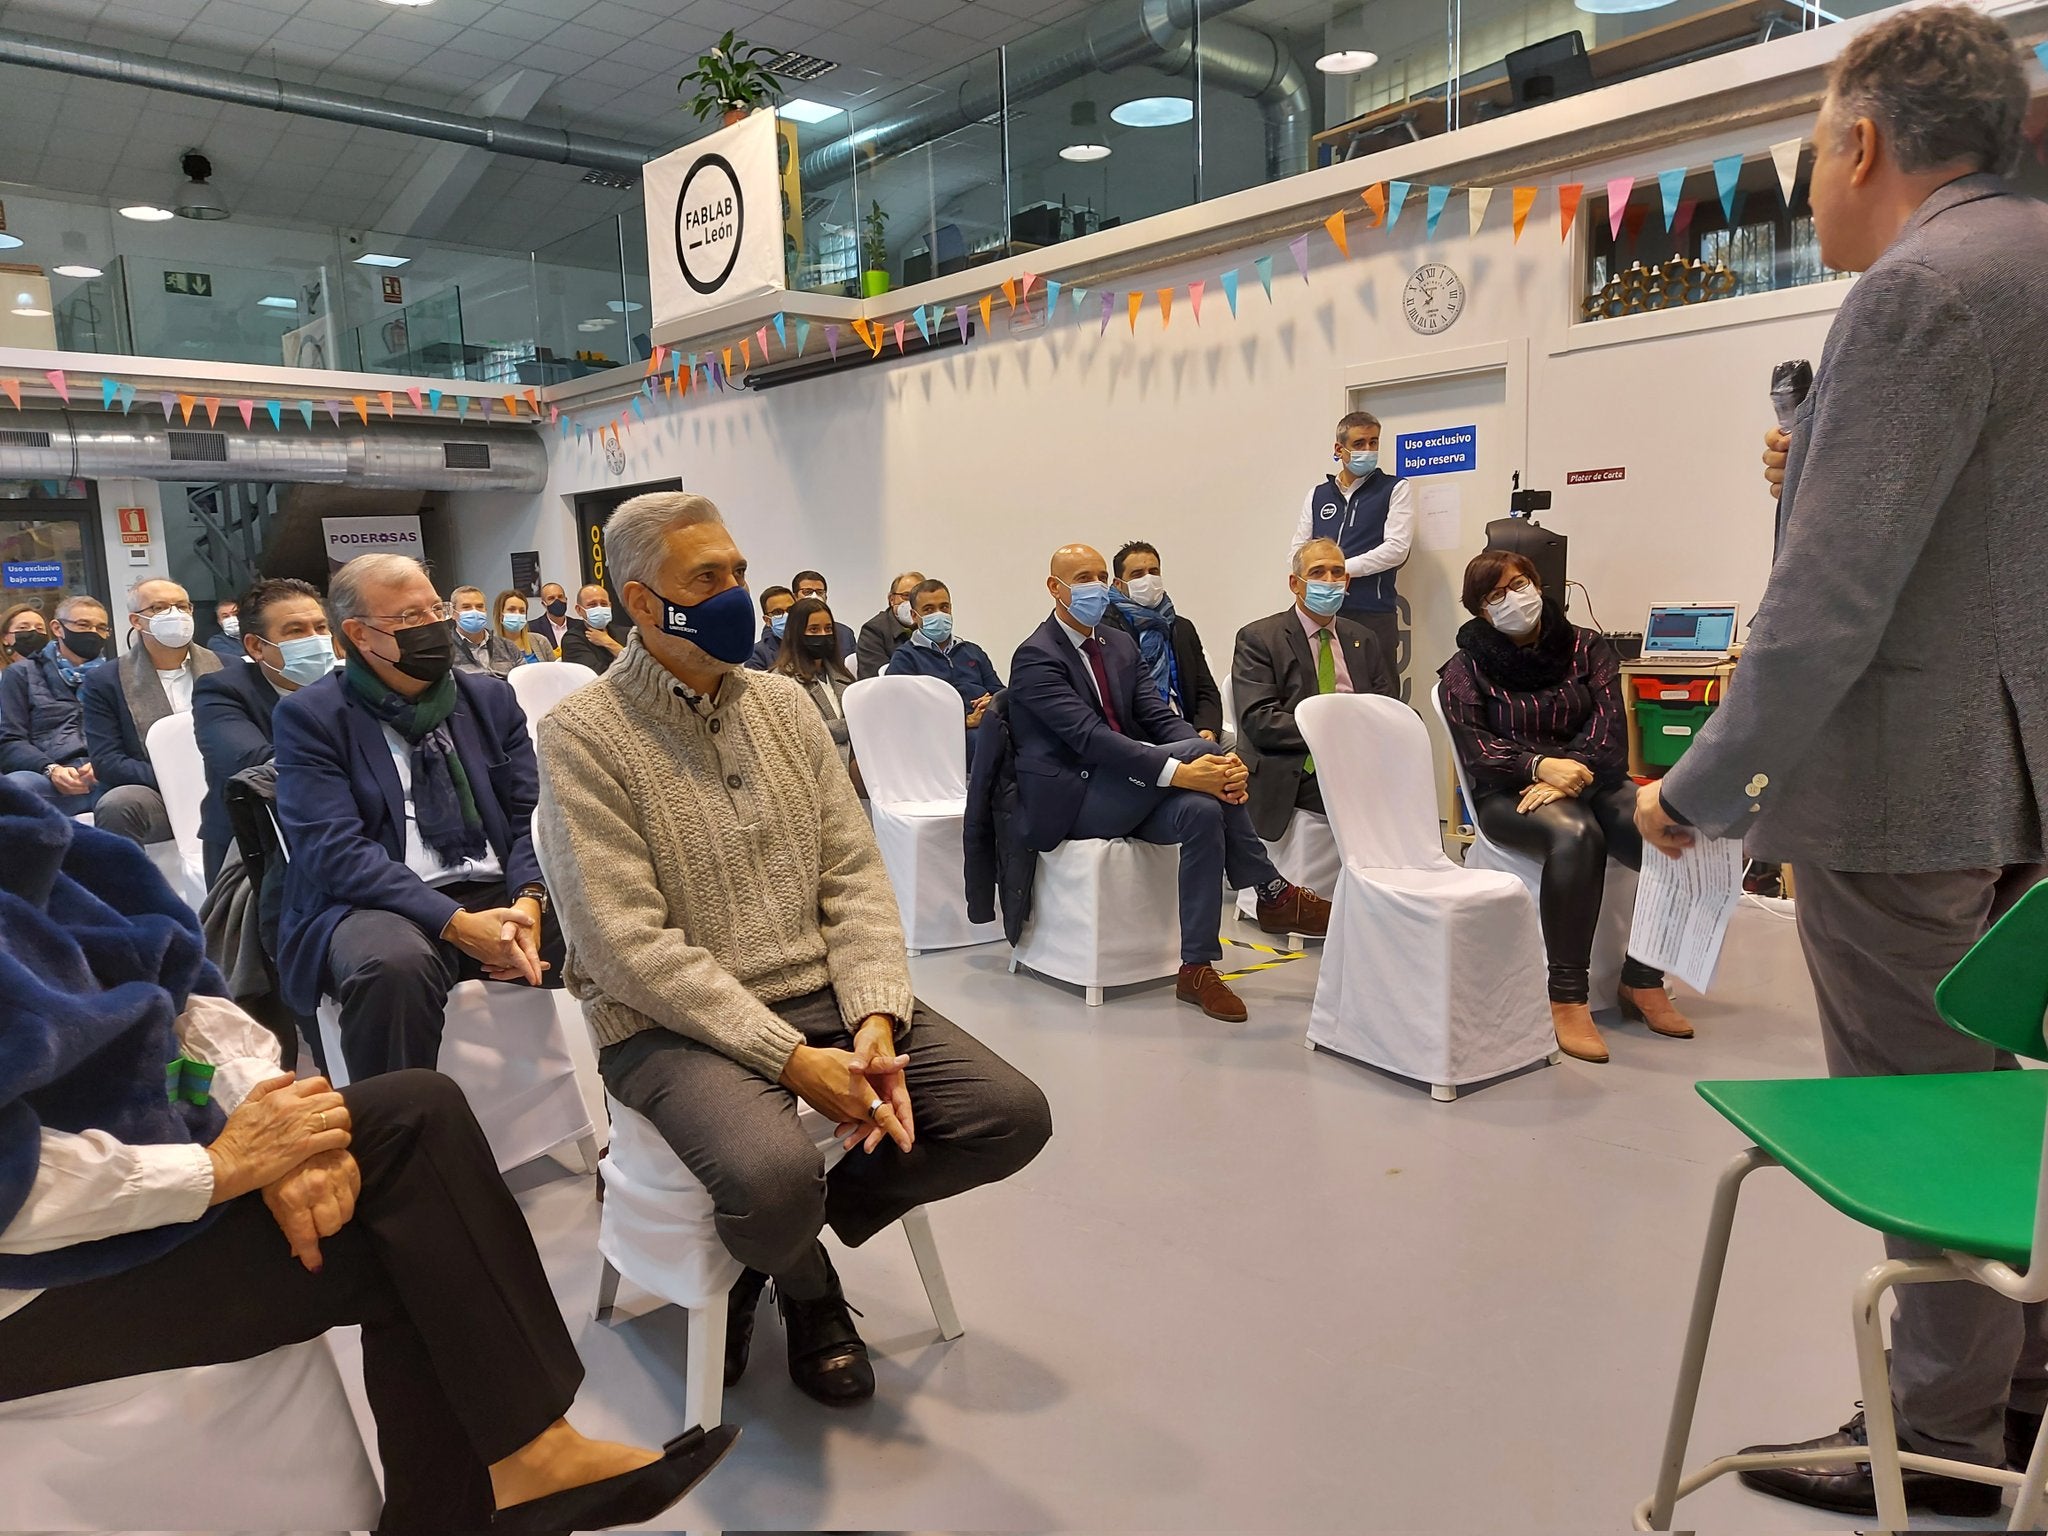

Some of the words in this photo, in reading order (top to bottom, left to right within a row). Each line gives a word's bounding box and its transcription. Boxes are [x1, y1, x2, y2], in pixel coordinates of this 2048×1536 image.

[686, 197, 733, 231] FABLAB
[705, 221, 733, 245] León
[1404, 440, 1423, 450] Uso
[1425, 433, 1472, 448] exclusivo
[1405, 457, 1427, 469] bajo
[1428, 453, 1466, 466] reserva
[1592, 472, 1602, 481] de
[1603, 471, 1623, 480] Corte
[24, 564, 61, 572] exclusivo
[9, 576, 28, 584] bajo
[668, 606, 687, 626] ie
